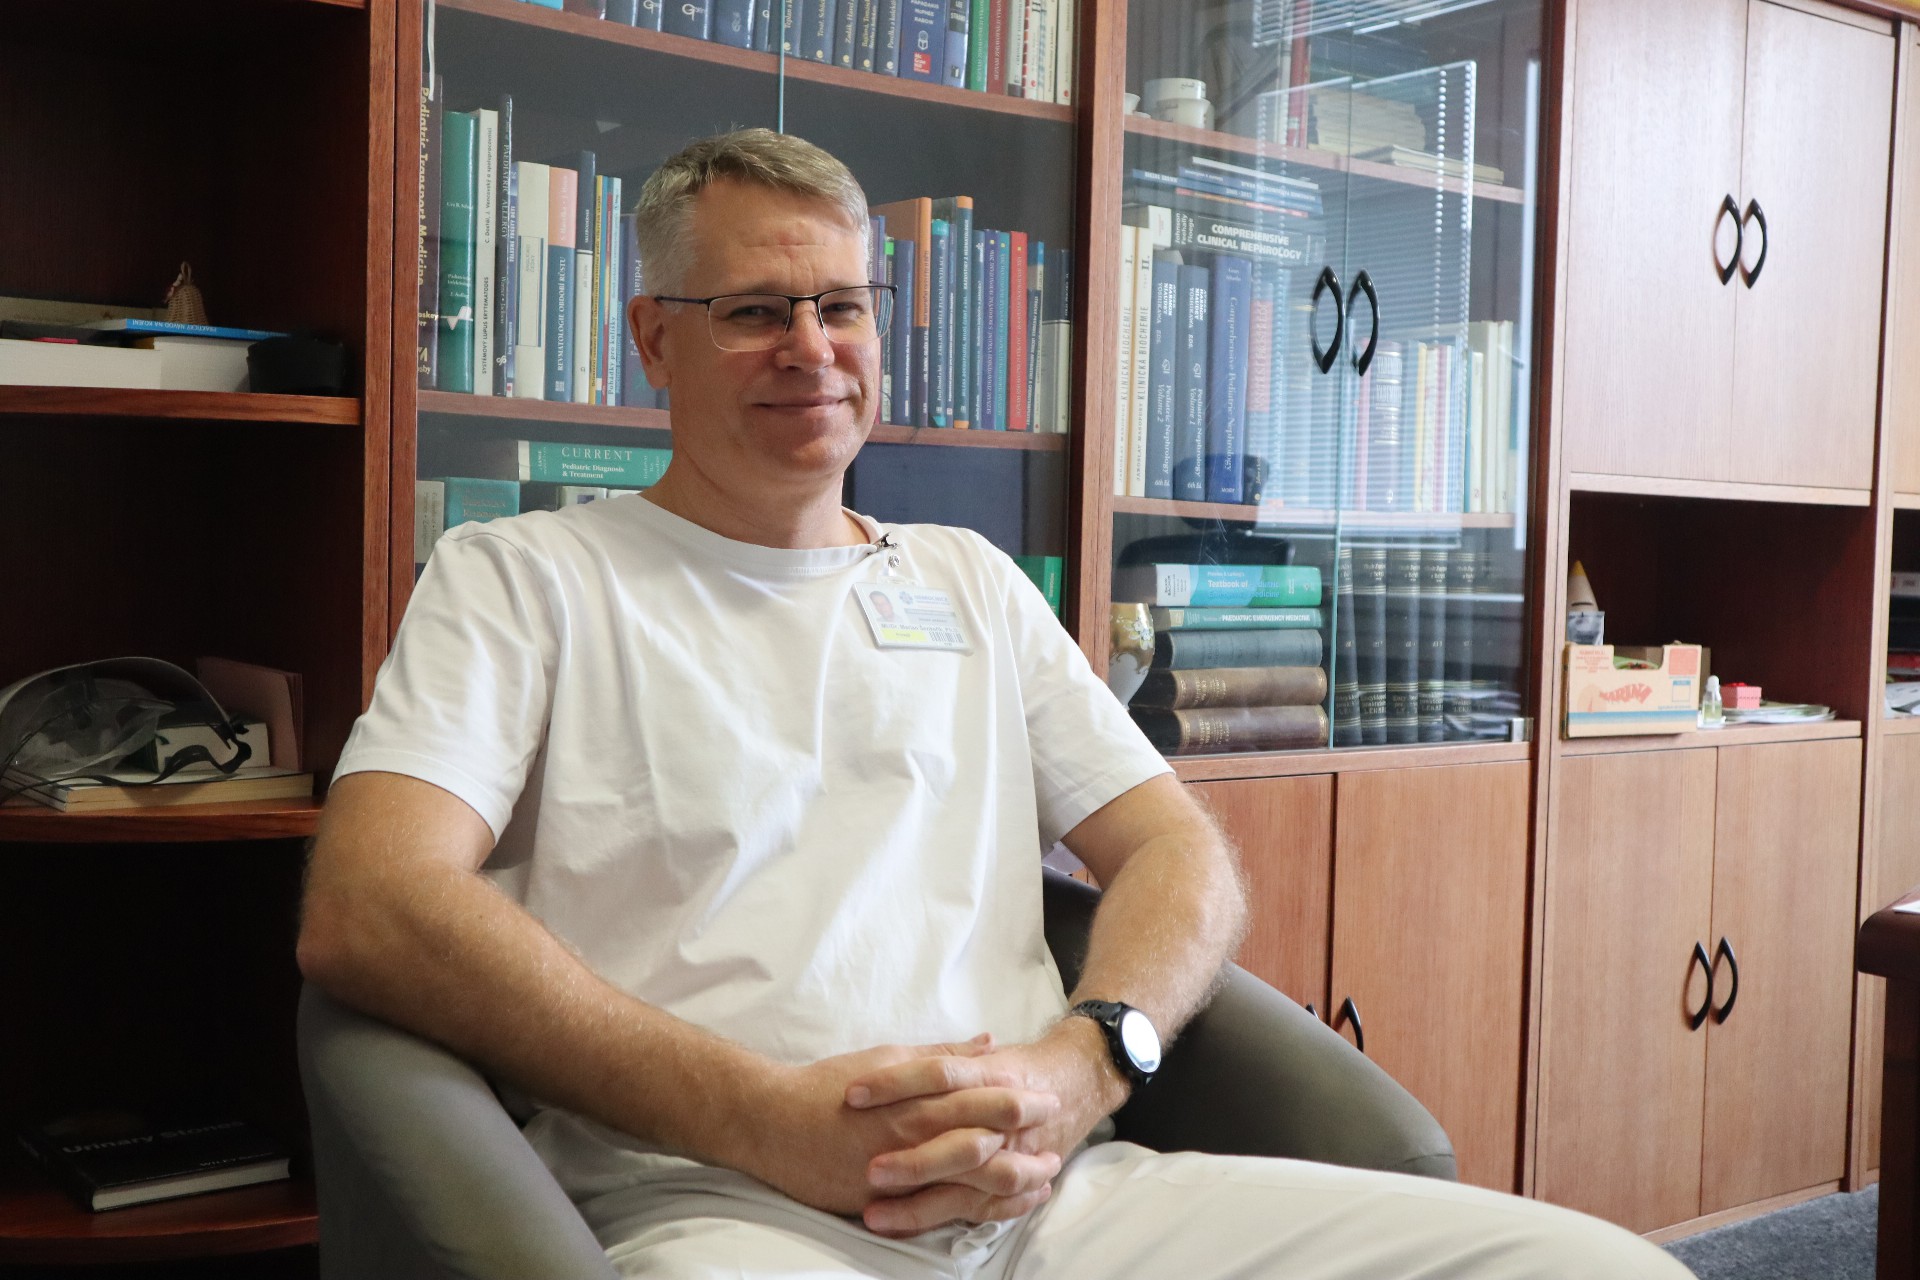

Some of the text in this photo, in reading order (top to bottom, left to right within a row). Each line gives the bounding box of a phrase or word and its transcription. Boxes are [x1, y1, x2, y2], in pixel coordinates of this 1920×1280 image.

[502, 200, 510, 239] ALLERGY
[1174, 212, 1182, 245] Johnson
[1181, 214, 1189, 246] Feehally
[1187, 217, 1195, 244] Floege
[1211, 224, 1290, 246] COMPREHENSIVE
[1197, 234, 1303, 260] CLINICAL NEPHROLOGY
[556, 256, 567, 371] REVMATOLOGIE OBDOBÍ RŮSTU
[1121, 306, 1132, 356] BIOCHEMIE
[1138, 305, 1149, 356] BIOCHEMIE
[1120, 359, 1130, 401] KLINICKÁ
[1137, 359, 1147, 400] KLINICKÁ
[1223, 296, 1239, 473] Comprehensive Pediatric Nephrology
[1157, 384, 1166, 415] Volume
[1189, 388, 1198, 419] Volume
[1162, 385, 1173, 475] Pediatric Nephrology
[1194, 389, 1204, 478] Pediatric Nephrology
[561, 446, 633, 461] CURRENT
[562, 463, 625, 473] Pediatric Diagnosis
[570, 471, 604, 479] Treatment
[1207, 579, 1240, 588] Textbook
[1221, 614, 1312, 622] PAEDIATRIC EMERGENCY MEDICINE
[62, 1136, 153, 1152] Urinary
